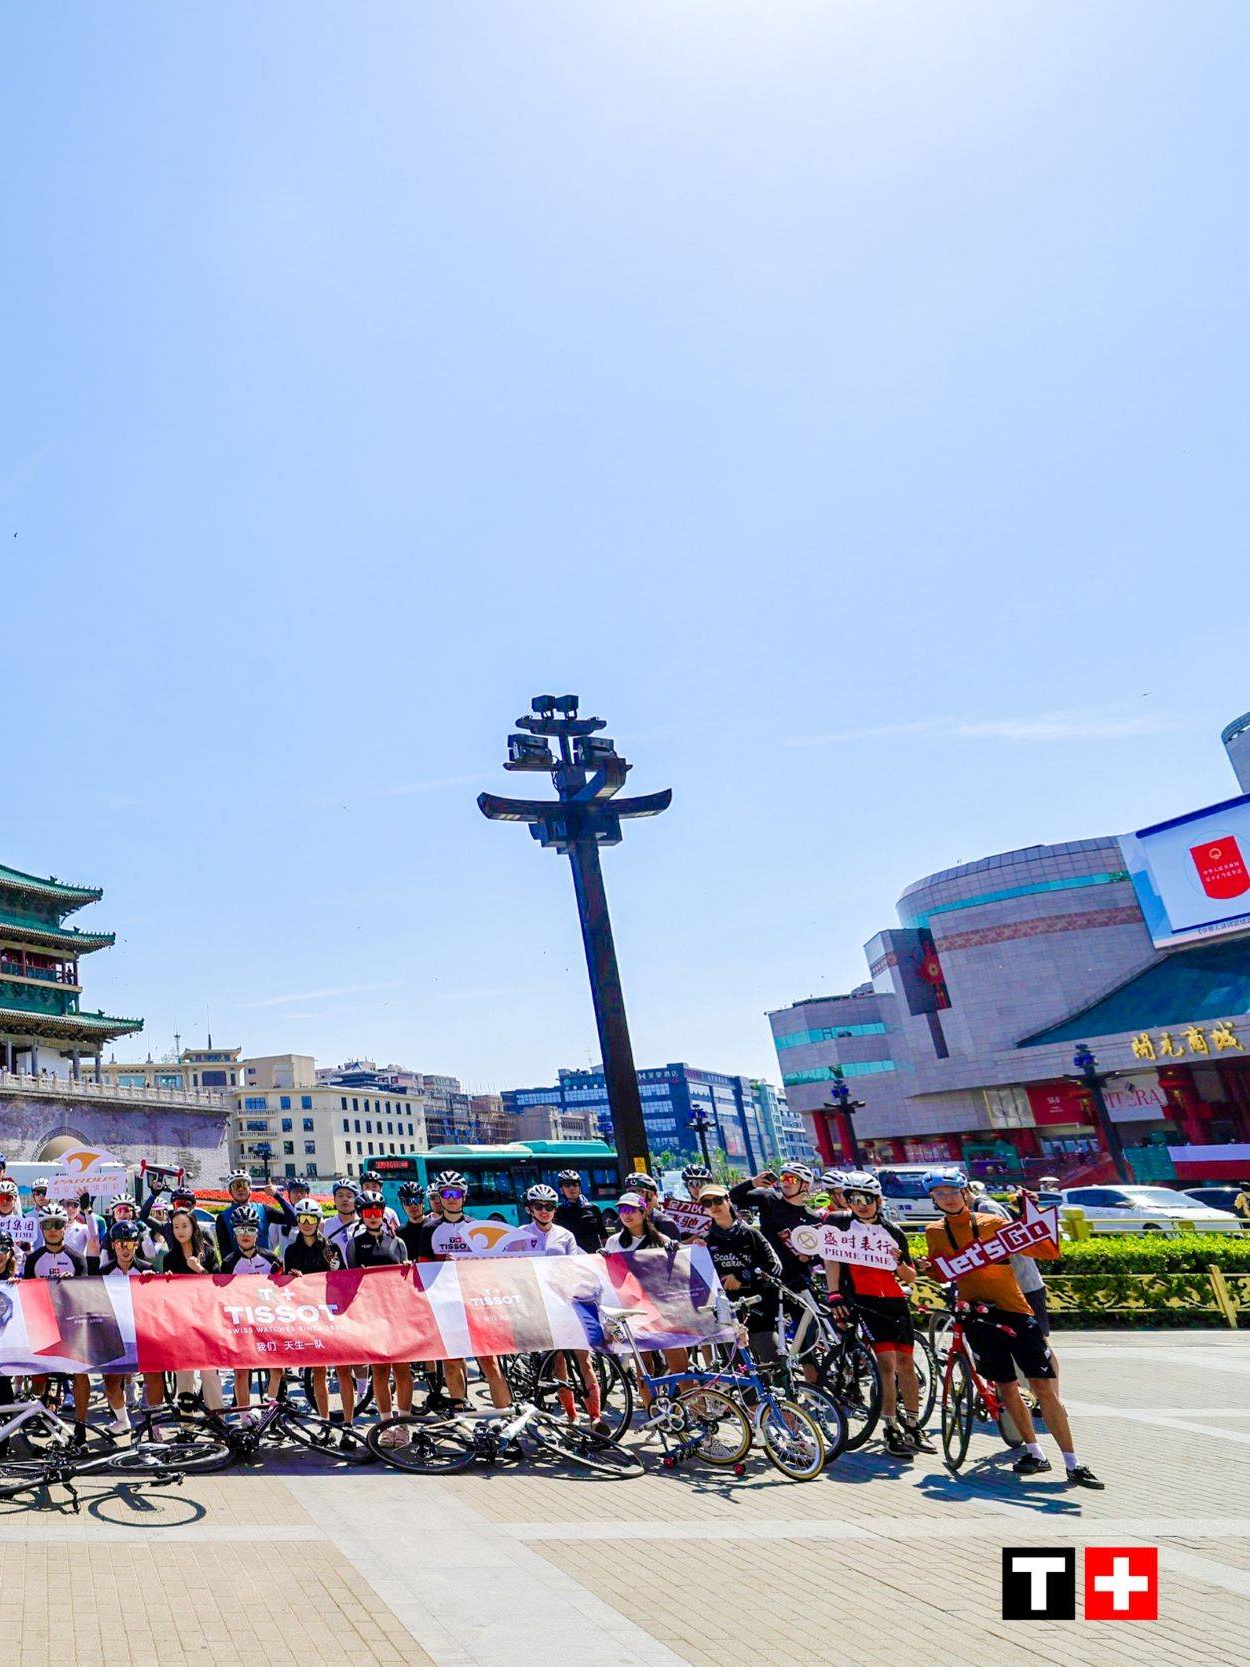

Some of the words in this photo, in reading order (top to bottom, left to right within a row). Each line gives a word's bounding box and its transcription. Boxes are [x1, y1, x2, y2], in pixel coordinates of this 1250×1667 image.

[824, 1231, 892, 1255] 盛时表行
[824, 1247, 860, 1260] PRIME
[862, 1253, 892, 1266] TIME
[259, 1288, 273, 1301] T
[469, 1294, 521, 1307] TISSOT
[223, 1303, 338, 1325] TISSOT
[256, 1342, 277, 1352] 我们
[284, 1339, 325, 1351] 天生一队
